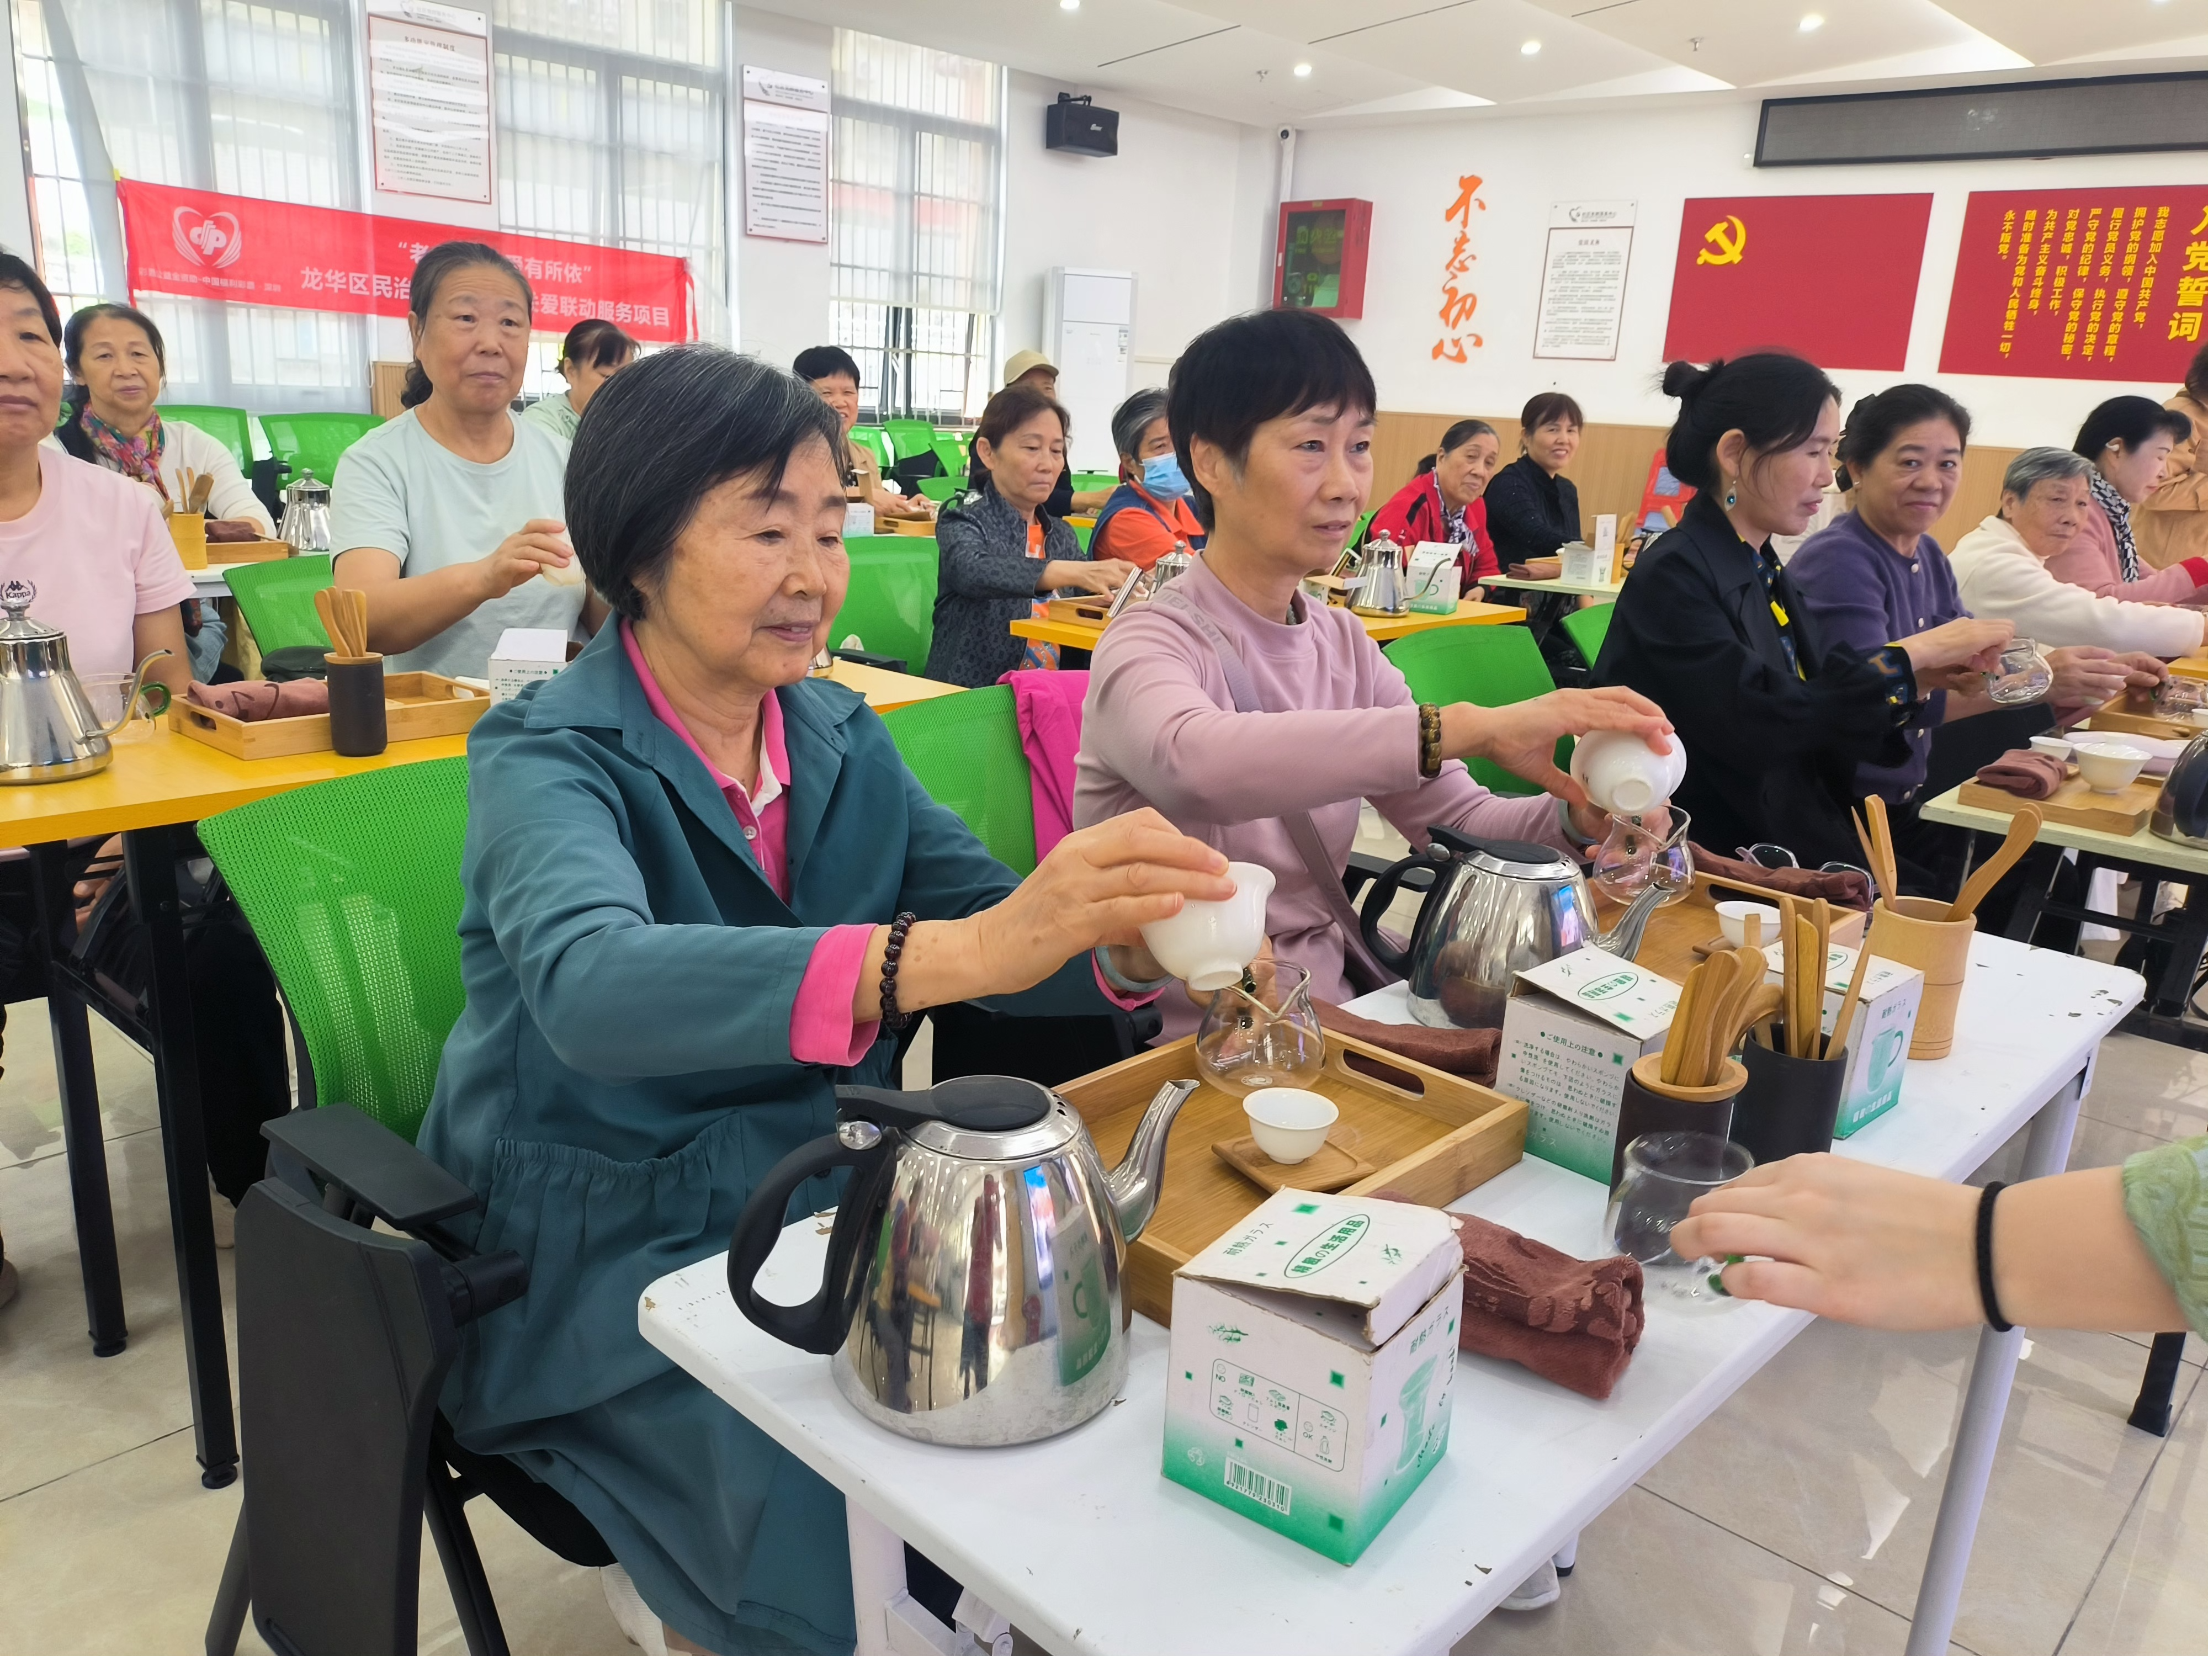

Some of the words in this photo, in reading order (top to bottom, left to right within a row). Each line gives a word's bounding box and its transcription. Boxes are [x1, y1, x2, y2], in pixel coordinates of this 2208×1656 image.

[1431, 174, 1487, 364] 不忘初心
[5, 590, 31, 599] Kappa
[1546, 1033, 1596, 1057] ご使用上の注意
[1222, 1222, 1274, 1256] 耐熱ガラス
[1215, 1373, 1226, 1383] NO
[1302, 1431, 1314, 1441] OK
